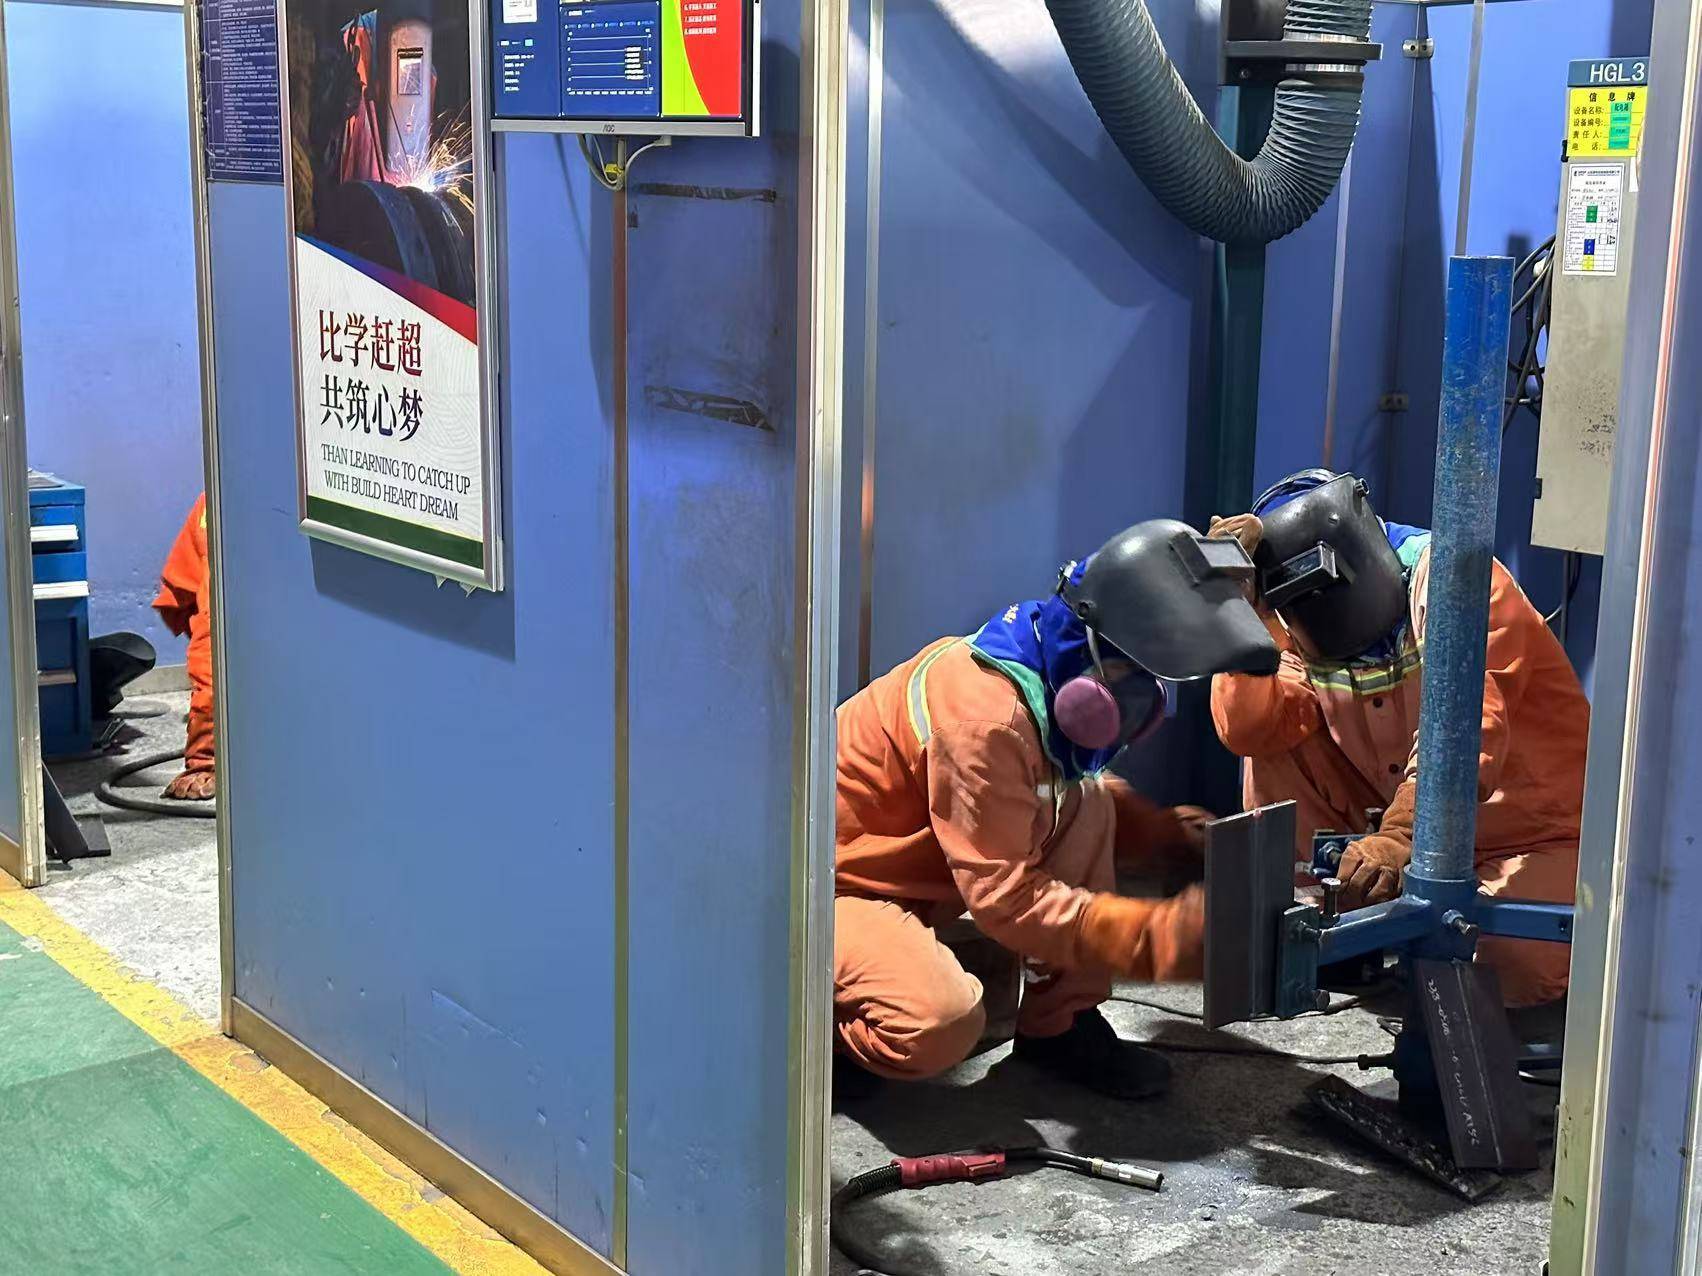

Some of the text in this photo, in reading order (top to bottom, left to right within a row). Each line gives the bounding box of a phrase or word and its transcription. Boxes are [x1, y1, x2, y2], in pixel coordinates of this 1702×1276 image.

[1589, 62, 1645, 83] HGL3
[1589, 91, 1636, 102] 信息牌
[319, 309, 423, 377] 比学赶超
[320, 374, 424, 442] 共筑心梦
[321, 443, 471, 495] THAN LEARNING TO CATCH UP
[324, 469, 459, 520] WITH BUILD HEART DREAM
